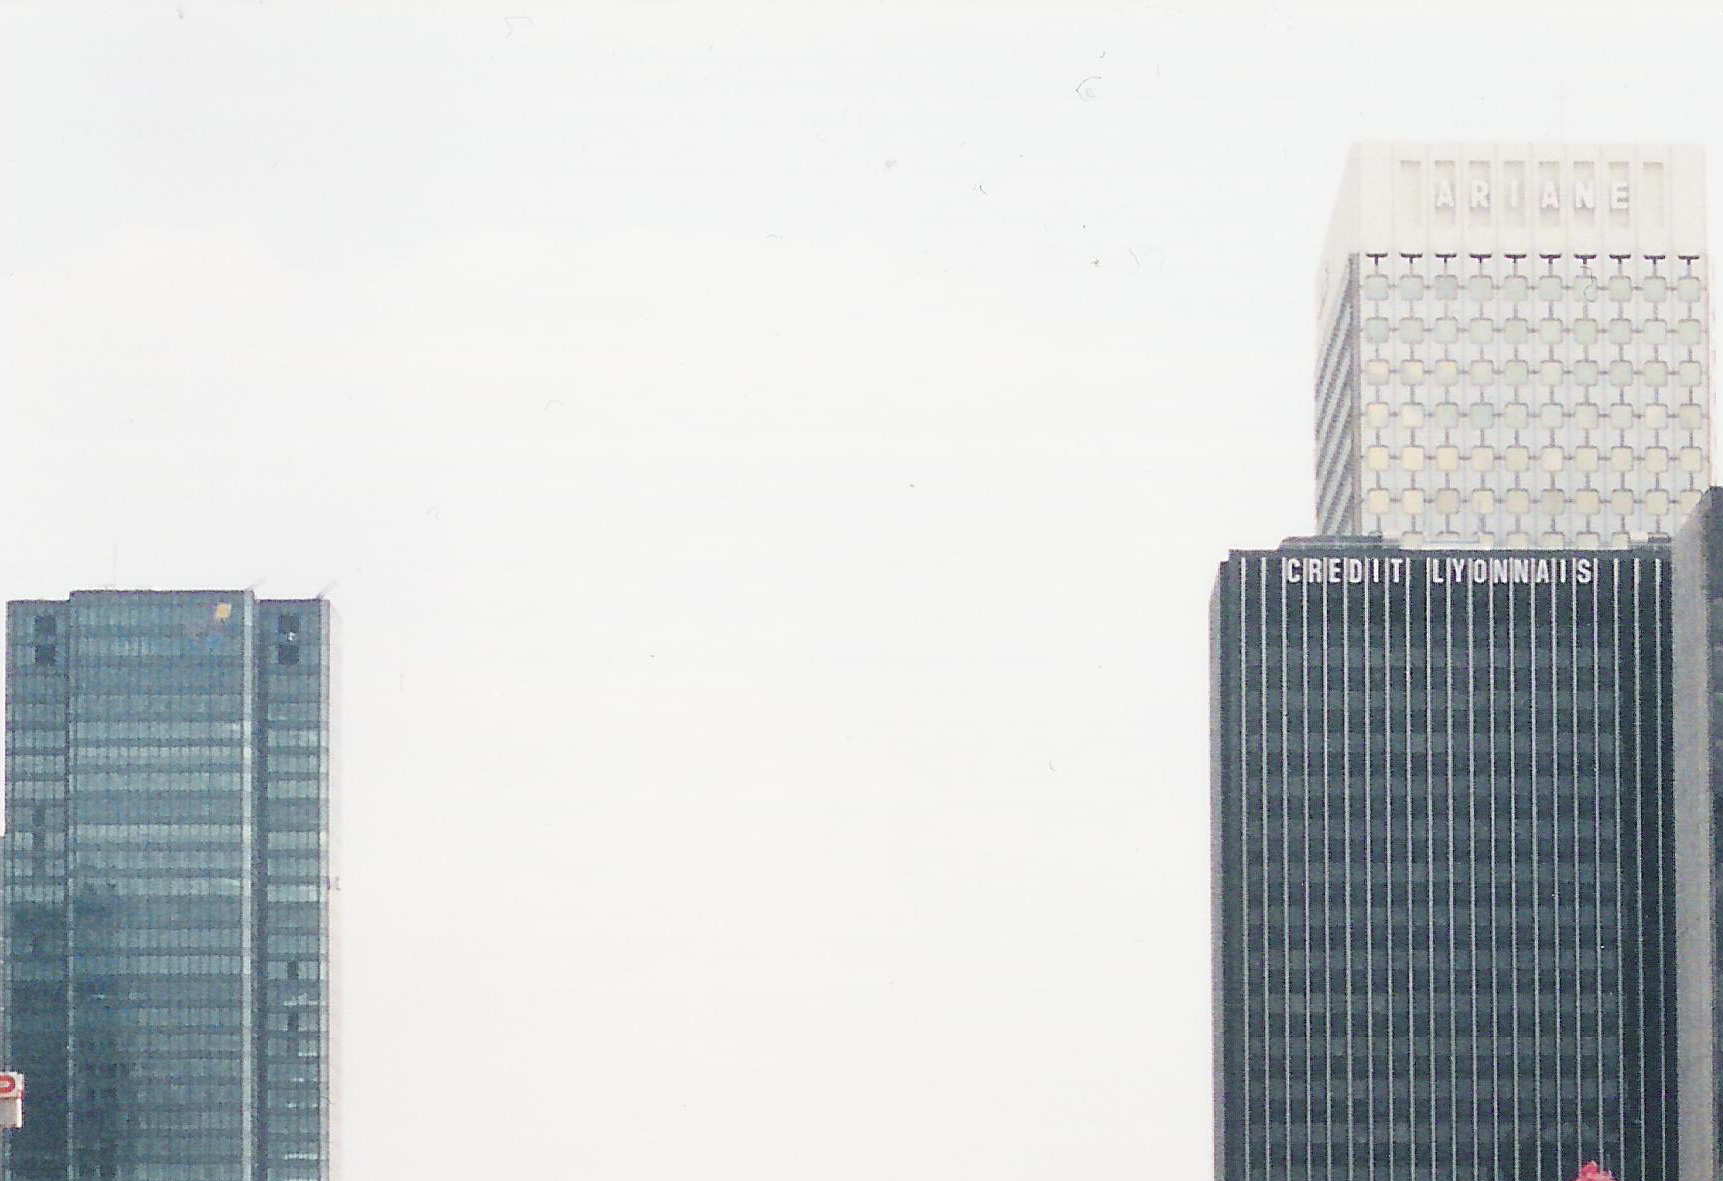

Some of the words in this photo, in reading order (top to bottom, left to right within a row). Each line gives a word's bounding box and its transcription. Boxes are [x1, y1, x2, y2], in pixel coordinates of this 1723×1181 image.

[1433, 179, 1629, 210] ARIANE
[1287, 557, 1403, 584] CREDIT
[1431, 557, 1592, 584] LYONNAIS
